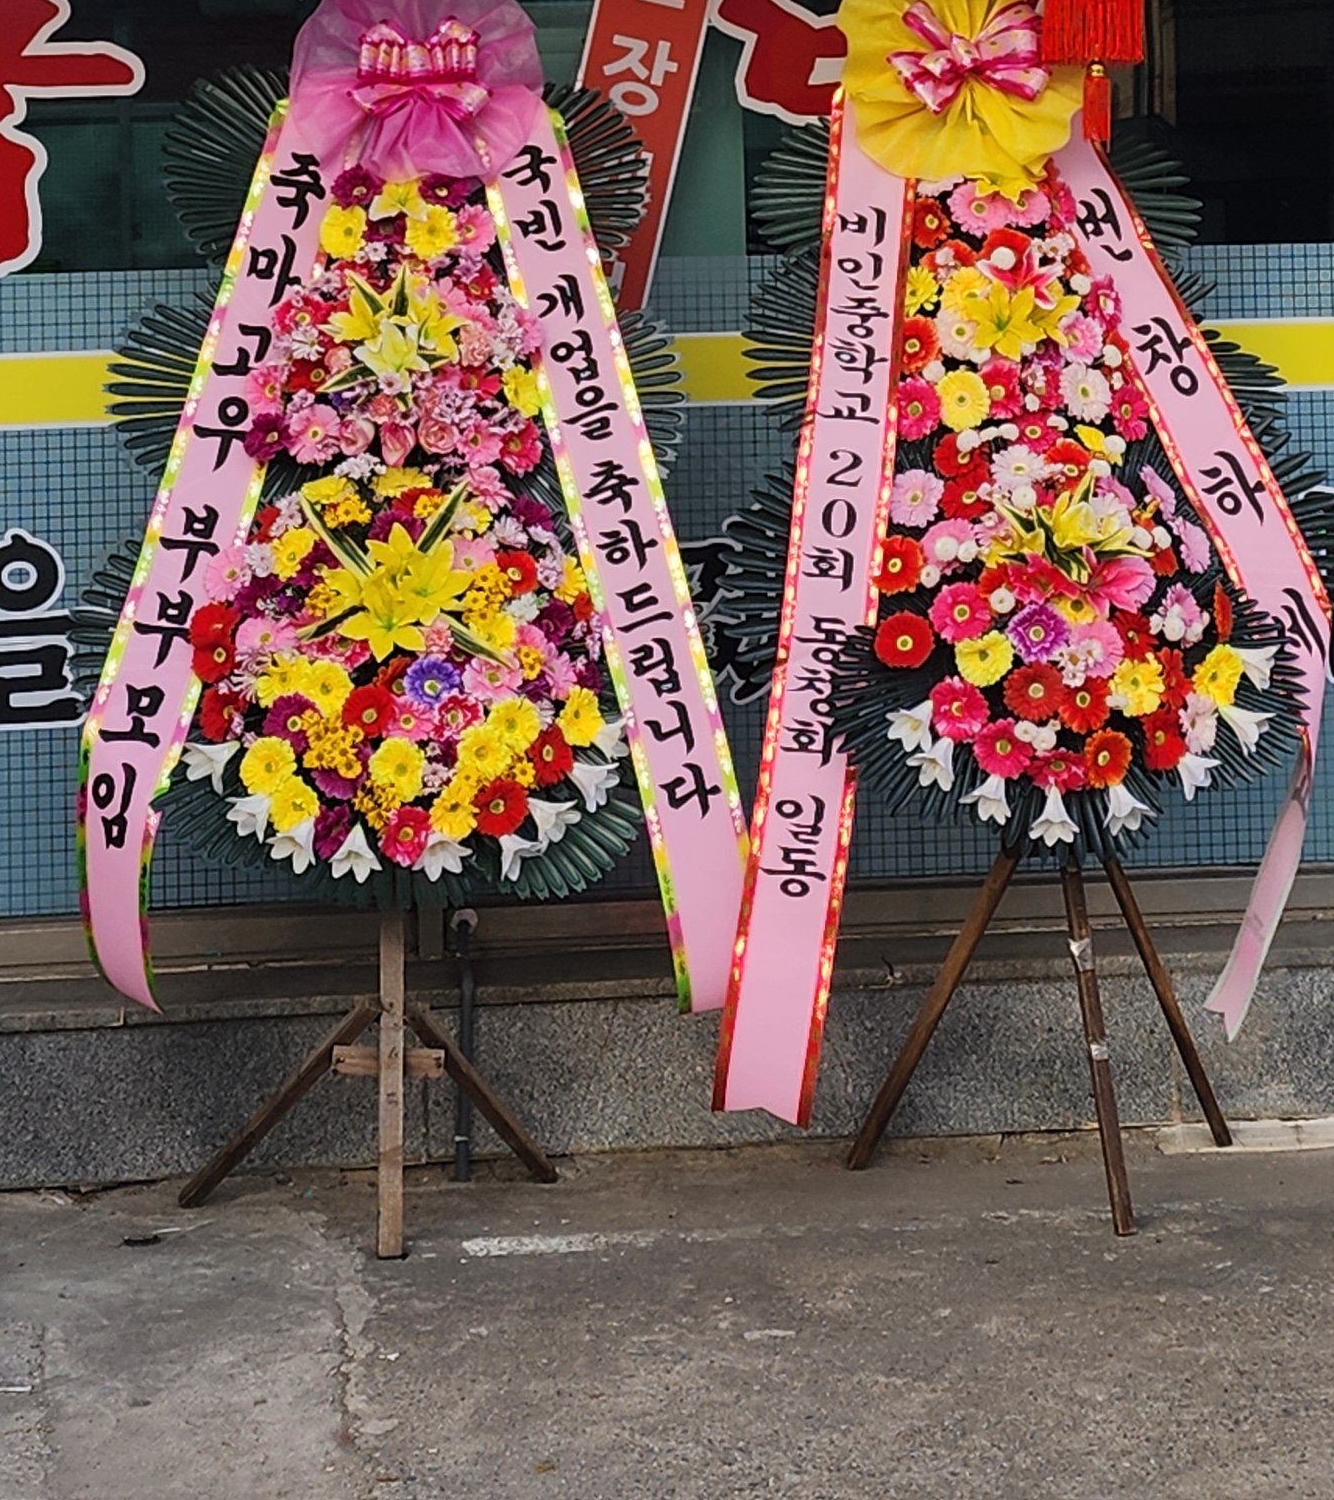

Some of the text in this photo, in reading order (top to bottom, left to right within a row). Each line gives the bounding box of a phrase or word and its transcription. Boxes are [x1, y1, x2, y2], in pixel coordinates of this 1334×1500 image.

[816, 205, 890, 426] 비인중학교
[91, 151, 327, 850] 죽마고우 부부모임
[501, 144, 723, 820] 국빈 개업을 축하드립니다
[800, 448, 865, 593] 20회
[759, 793, 829, 899] 일동
